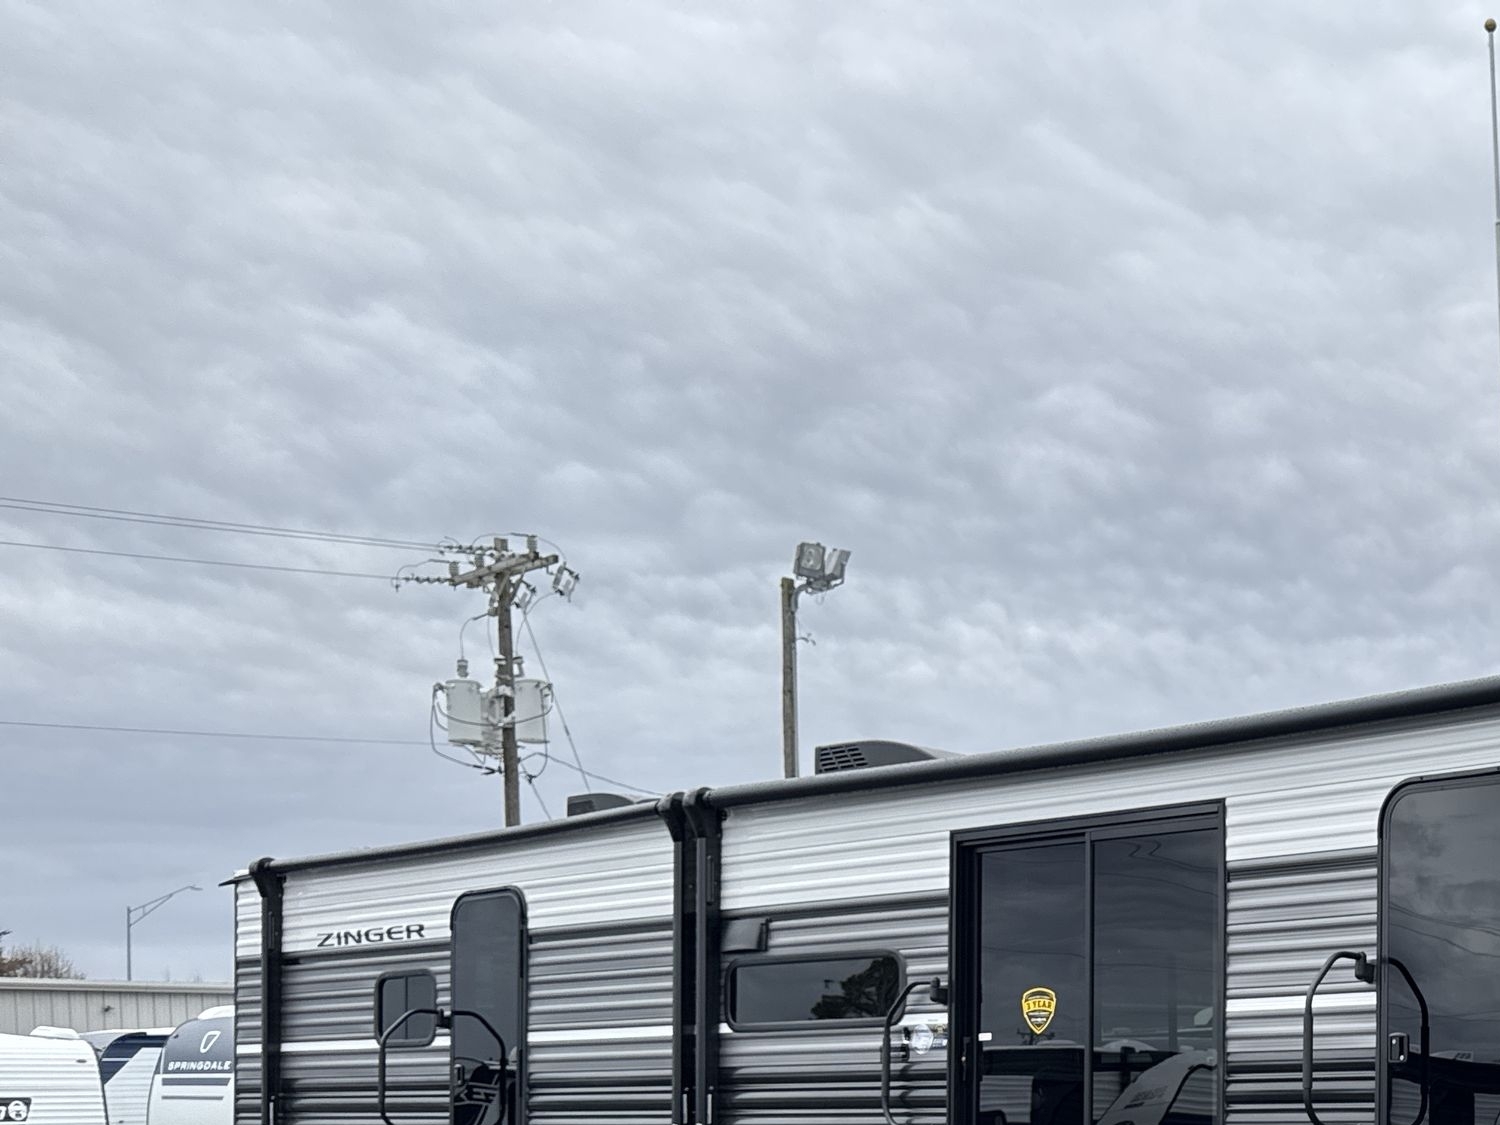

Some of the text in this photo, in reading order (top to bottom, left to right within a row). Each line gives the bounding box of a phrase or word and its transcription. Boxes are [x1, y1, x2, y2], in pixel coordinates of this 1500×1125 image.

[317, 923, 425, 947] ZINGER
[1032, 1000, 1052, 1010] YEAR
[167, 1060, 232, 1071] SPRINGDALE
